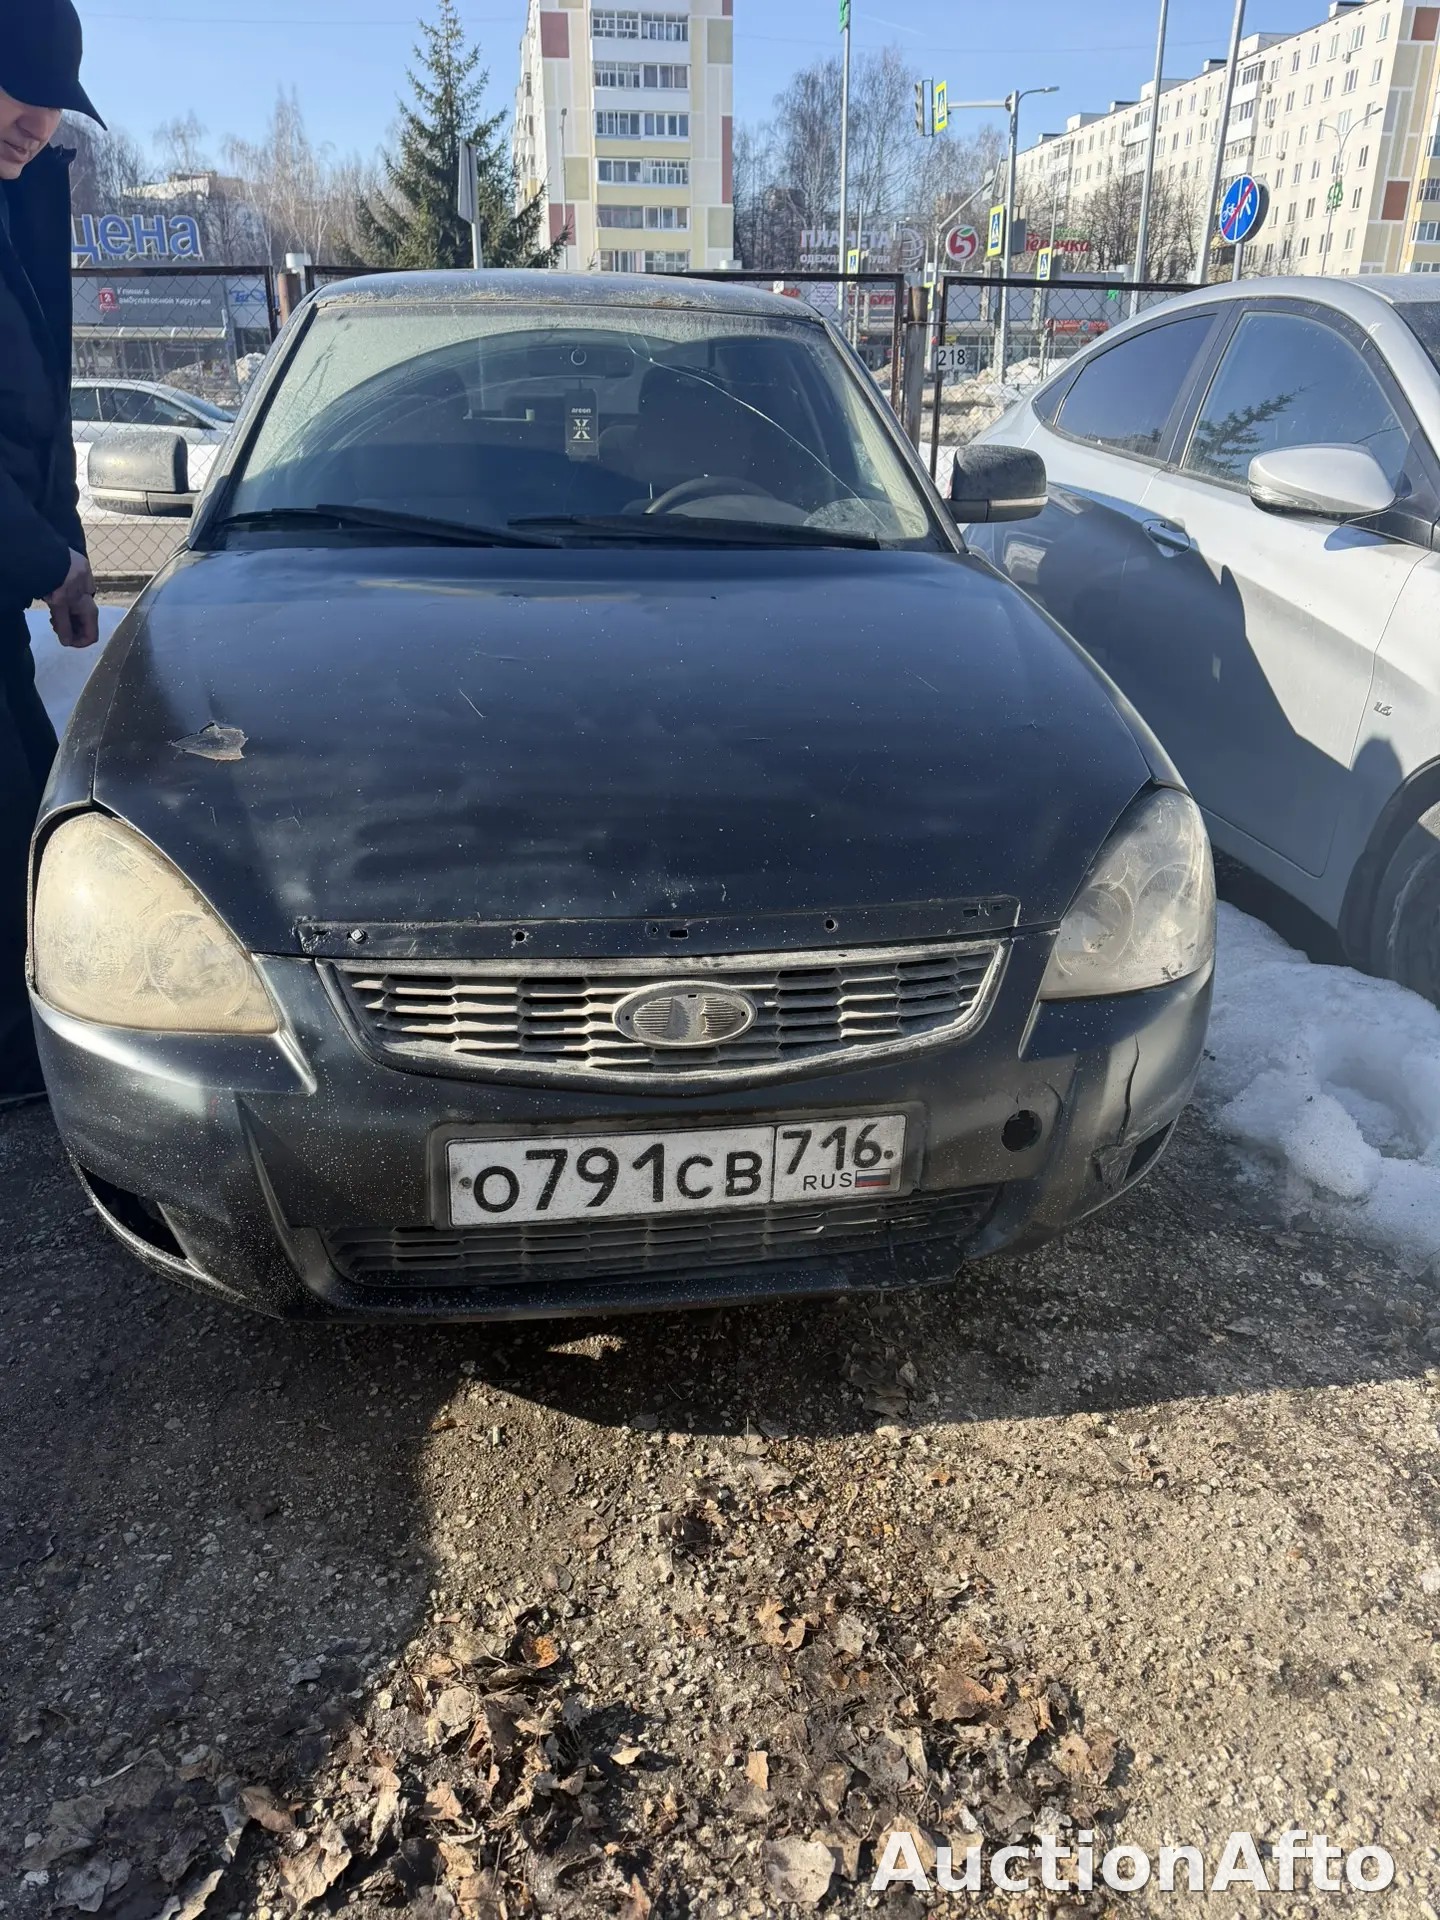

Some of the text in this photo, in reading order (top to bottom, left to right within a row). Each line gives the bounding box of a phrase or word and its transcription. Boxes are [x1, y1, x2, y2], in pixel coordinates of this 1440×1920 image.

[800, 254, 841, 264] ОДЕЖД
[938, 349, 966, 366] 218
[782, 1123, 883, 1176] 716
[803, 1171, 852, 1191] RUS
